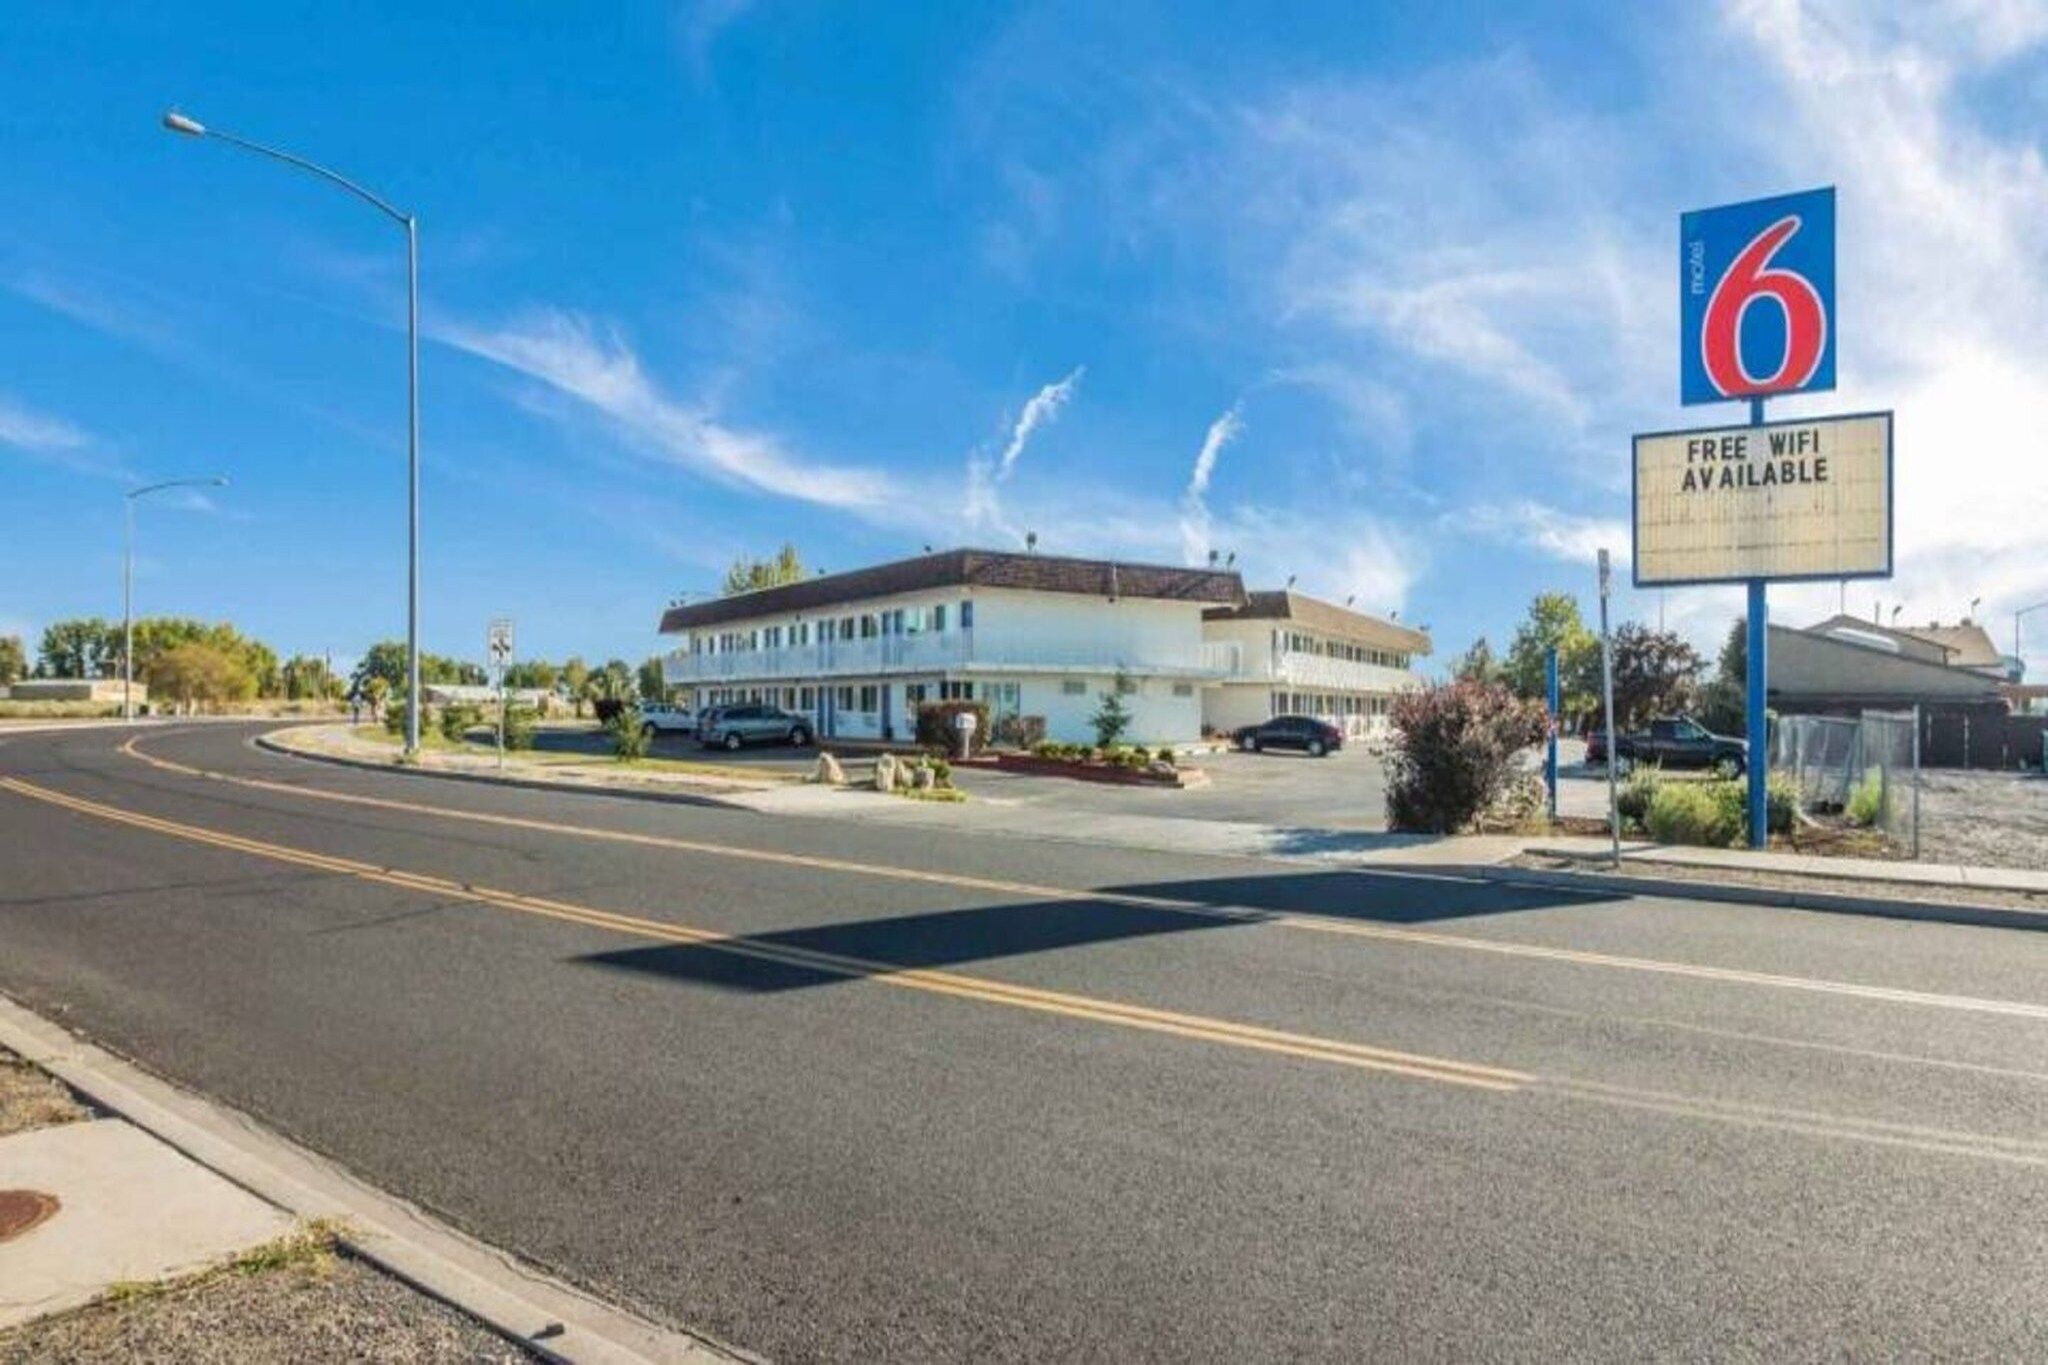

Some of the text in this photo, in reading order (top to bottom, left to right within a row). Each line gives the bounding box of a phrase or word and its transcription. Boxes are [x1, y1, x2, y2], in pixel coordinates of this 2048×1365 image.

[1702, 214, 1827, 397] 6
[1688, 429, 1820, 463] FREE WIFI
[1682, 459, 1828, 492] AVAILABLE
